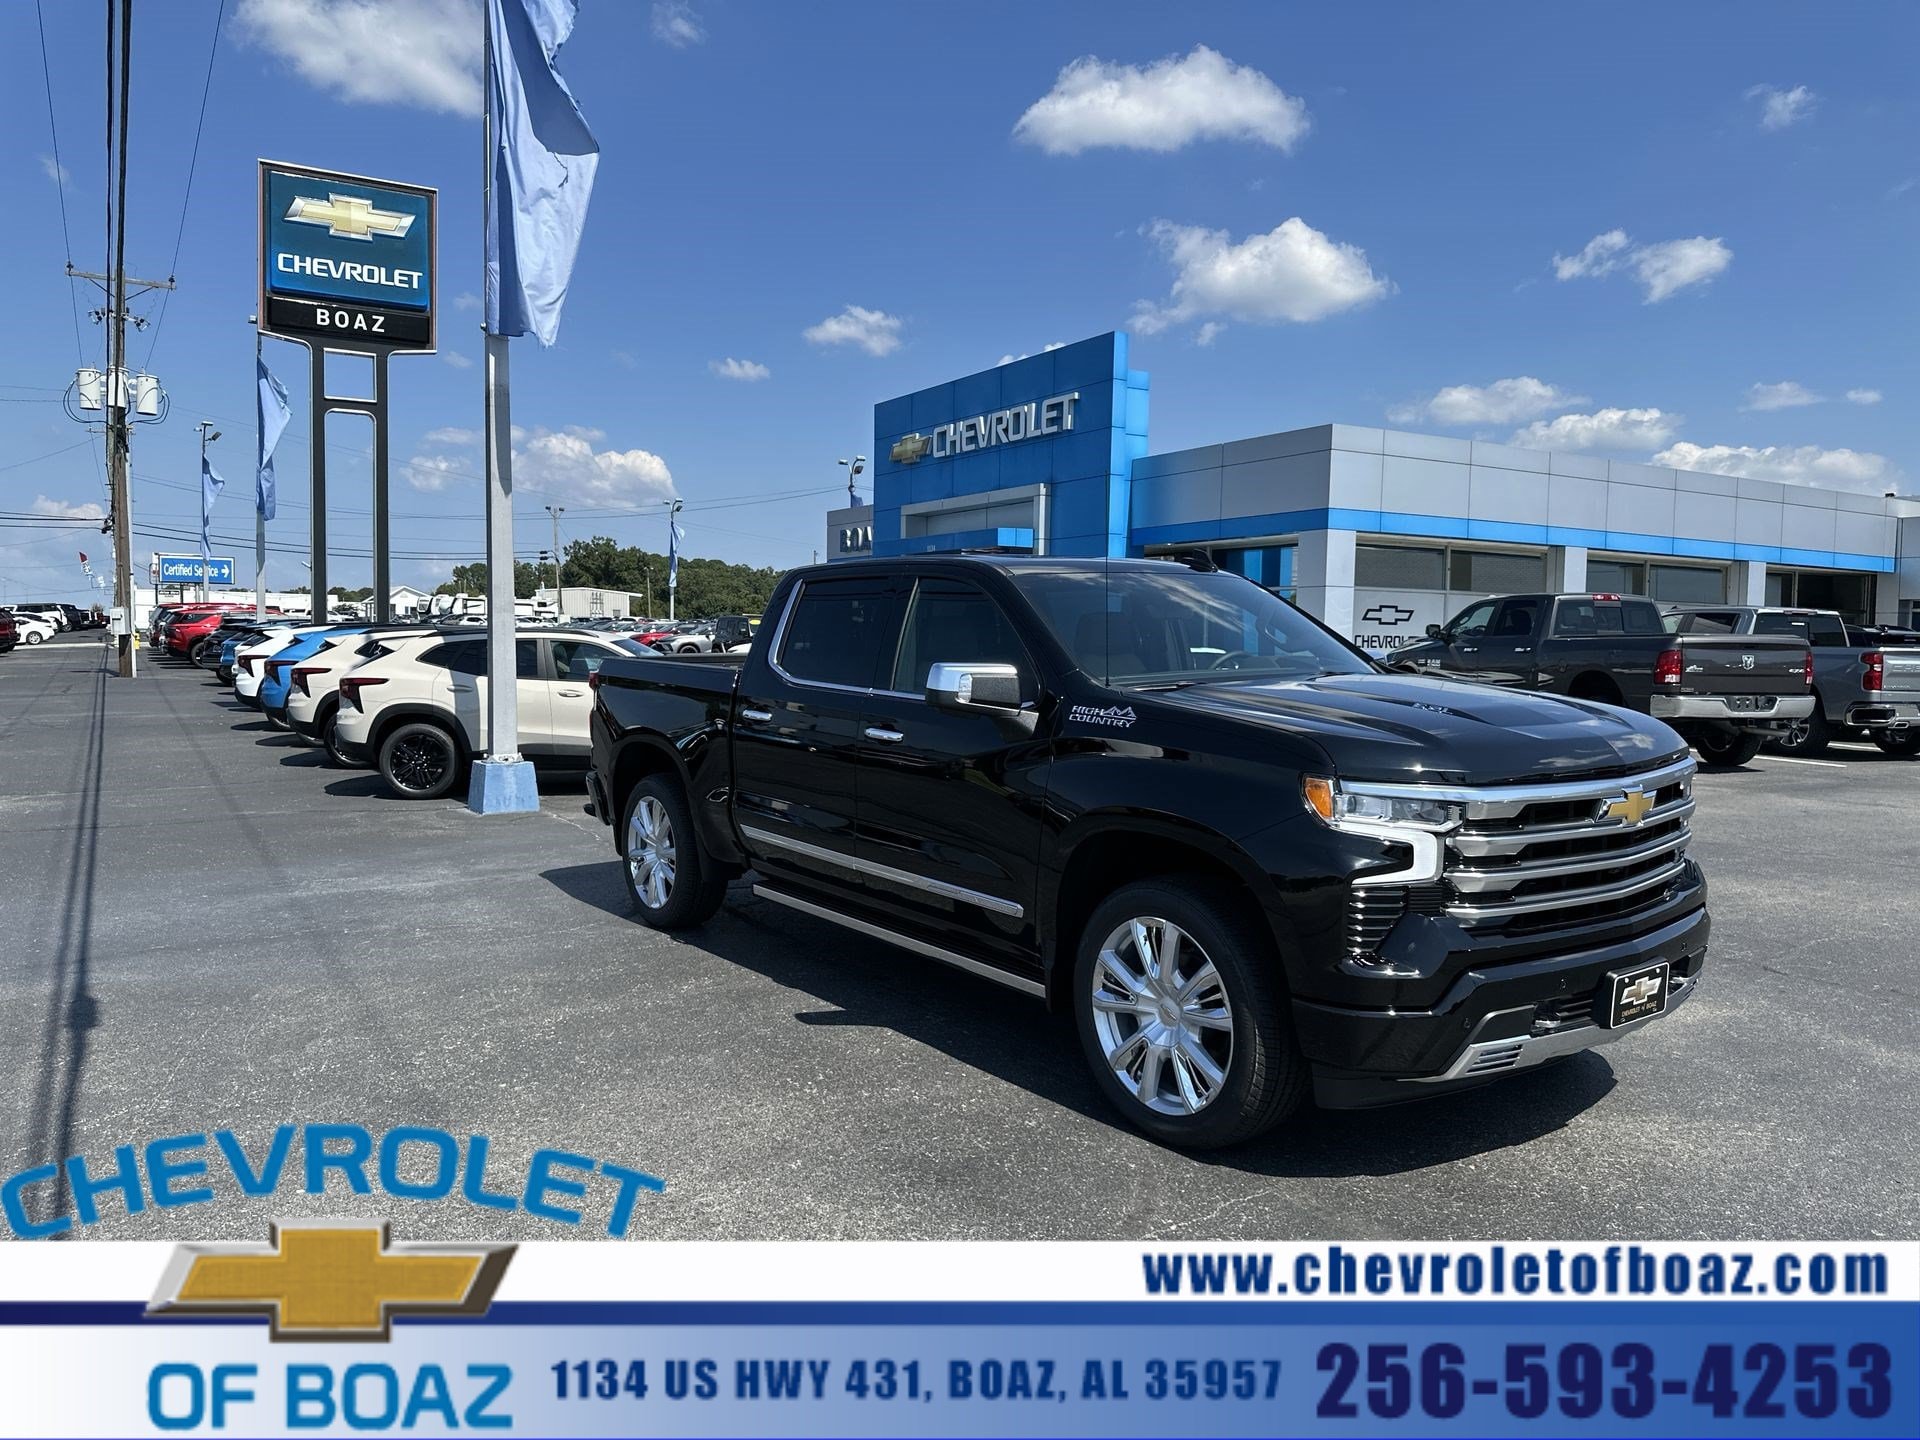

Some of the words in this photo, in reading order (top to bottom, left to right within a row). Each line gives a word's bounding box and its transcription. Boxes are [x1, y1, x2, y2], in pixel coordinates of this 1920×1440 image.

[277, 253, 424, 289] CHEVROLET
[315, 308, 385, 333] BOAZ
[933, 391, 1080, 458] CHEVROLET
[840, 526, 873, 553] BOA
[163, 563, 193, 577] Certified
[194, 564, 219, 577] Seice
[1354, 634, 1405, 649] CHEVRO
[1071, 705, 1105, 716] HIGH
[1069, 714, 1136, 728] COUNTRY
